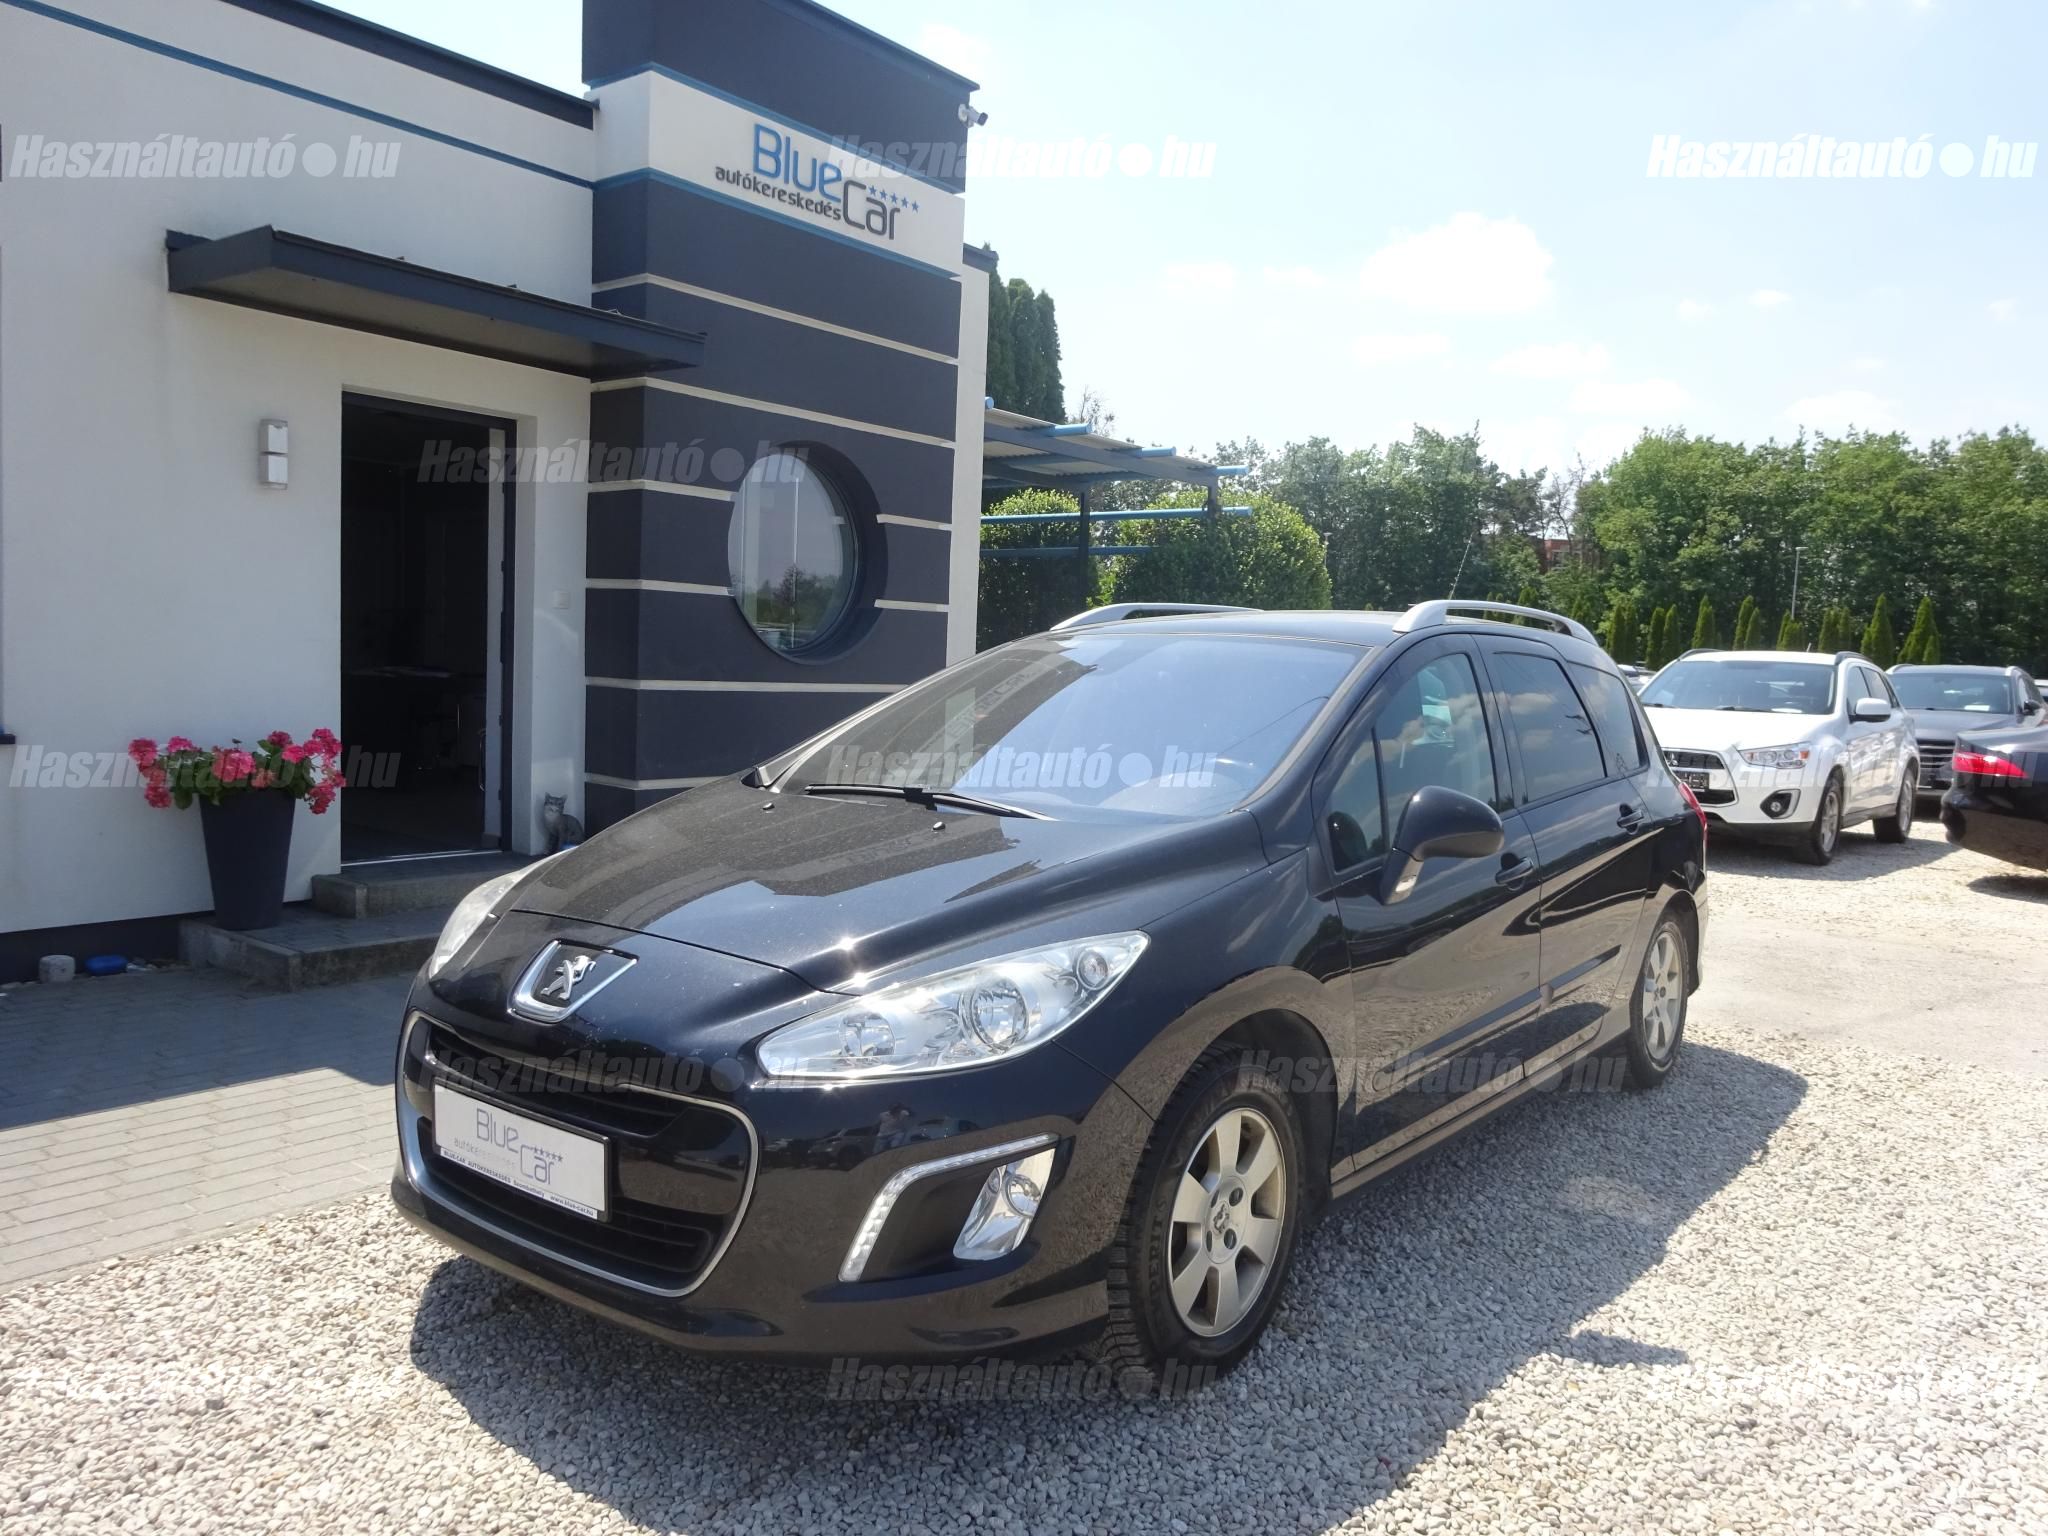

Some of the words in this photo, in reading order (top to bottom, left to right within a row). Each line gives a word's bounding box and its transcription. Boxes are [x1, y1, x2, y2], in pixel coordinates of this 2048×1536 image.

[714, 166, 841, 220] autókereskedés
[753, 123, 842, 202] Blue
[842, 180, 900, 240] Car
[476, 1108, 519, 1153] Blue
[520, 1144, 555, 1185] Car
